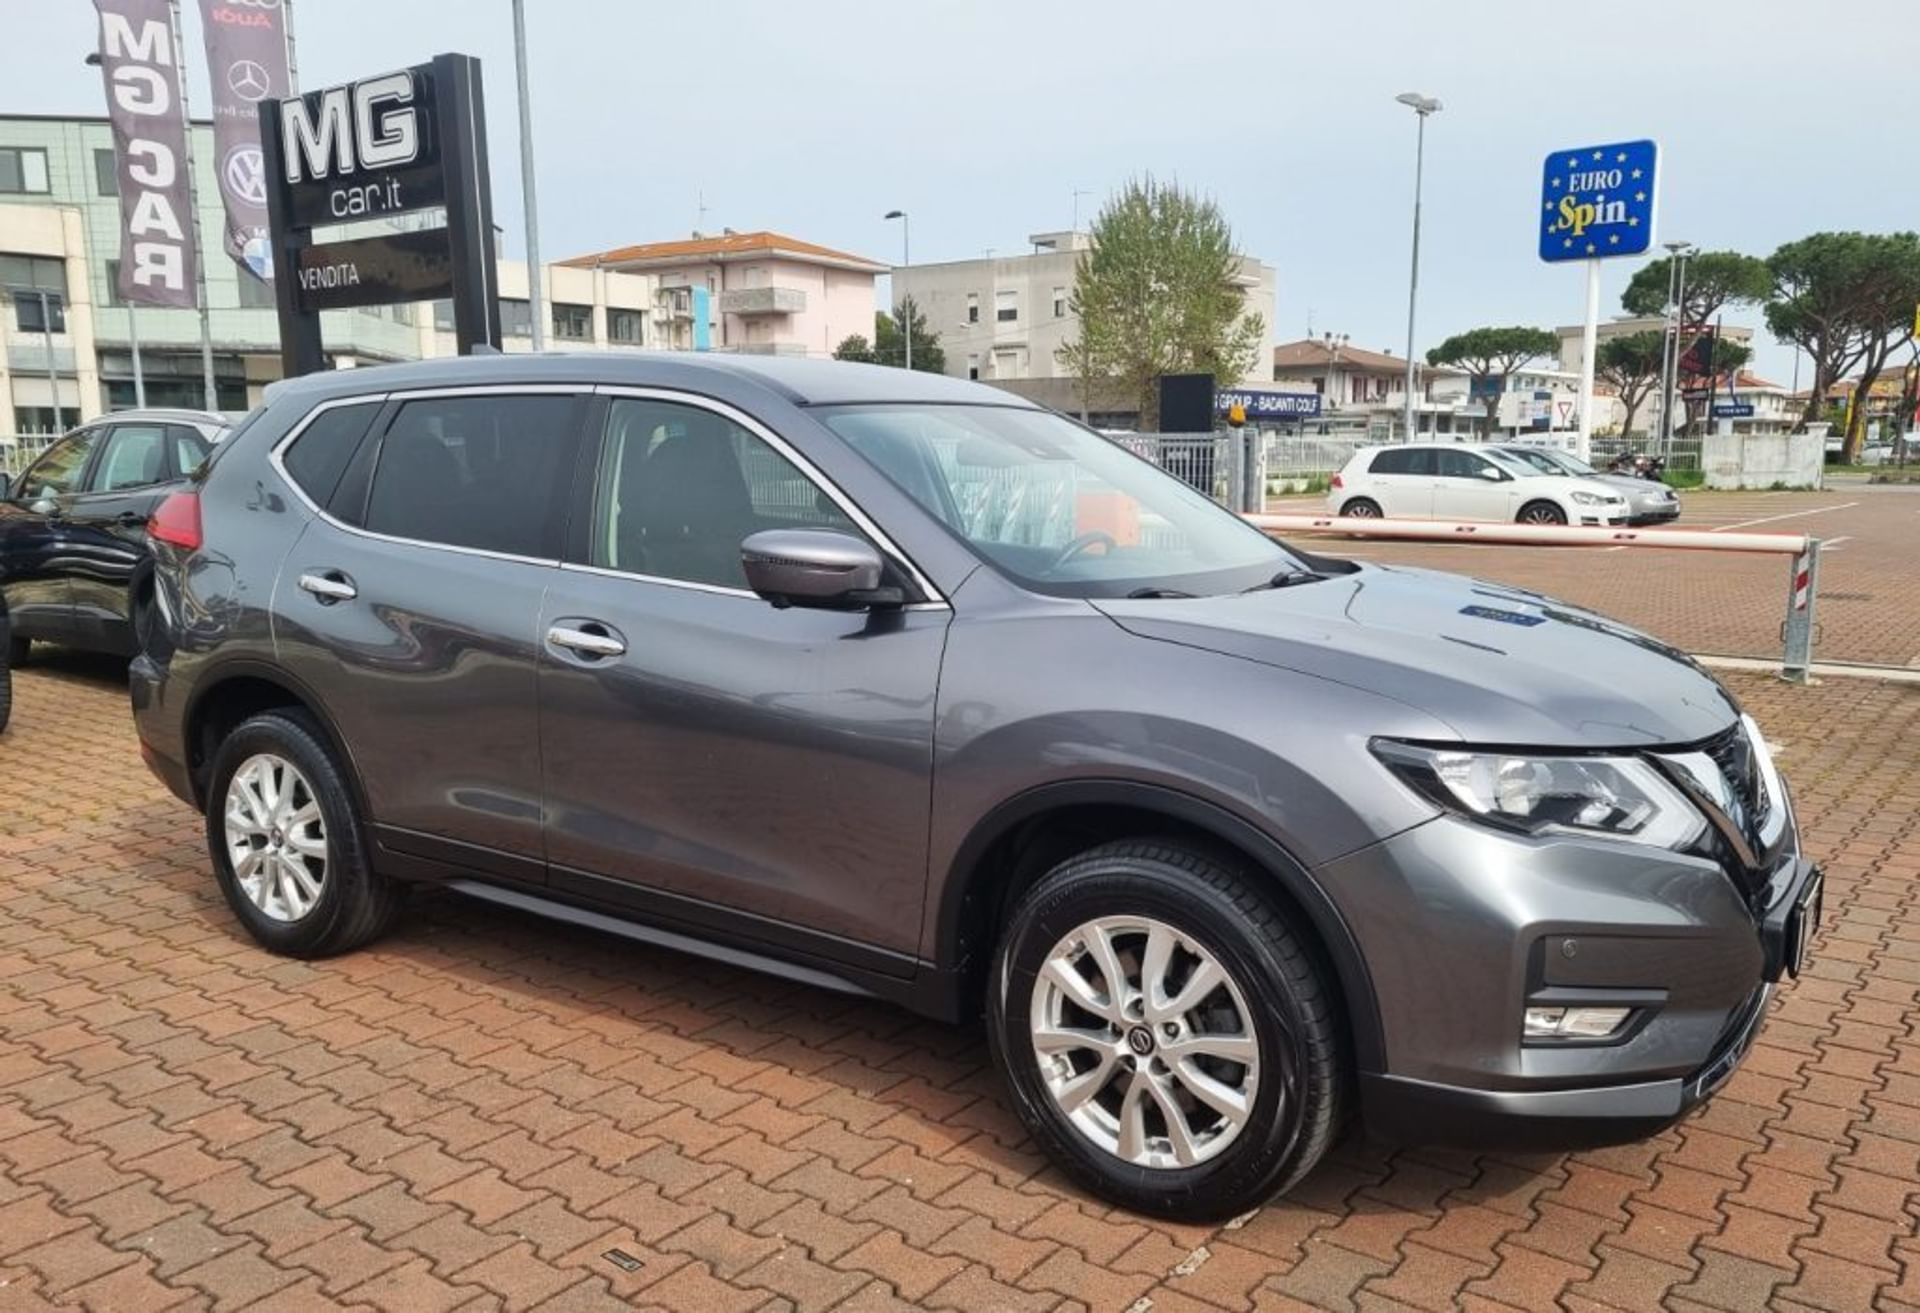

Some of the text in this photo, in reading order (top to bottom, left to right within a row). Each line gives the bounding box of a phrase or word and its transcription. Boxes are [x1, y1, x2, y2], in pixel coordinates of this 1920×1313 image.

[280, 69, 418, 184] MG
[330, 178, 403, 217] car.it
[1568, 168, 1623, 193] EURO
[1557, 194, 1627, 235] Spin
[298, 263, 360, 290] VENDITA
